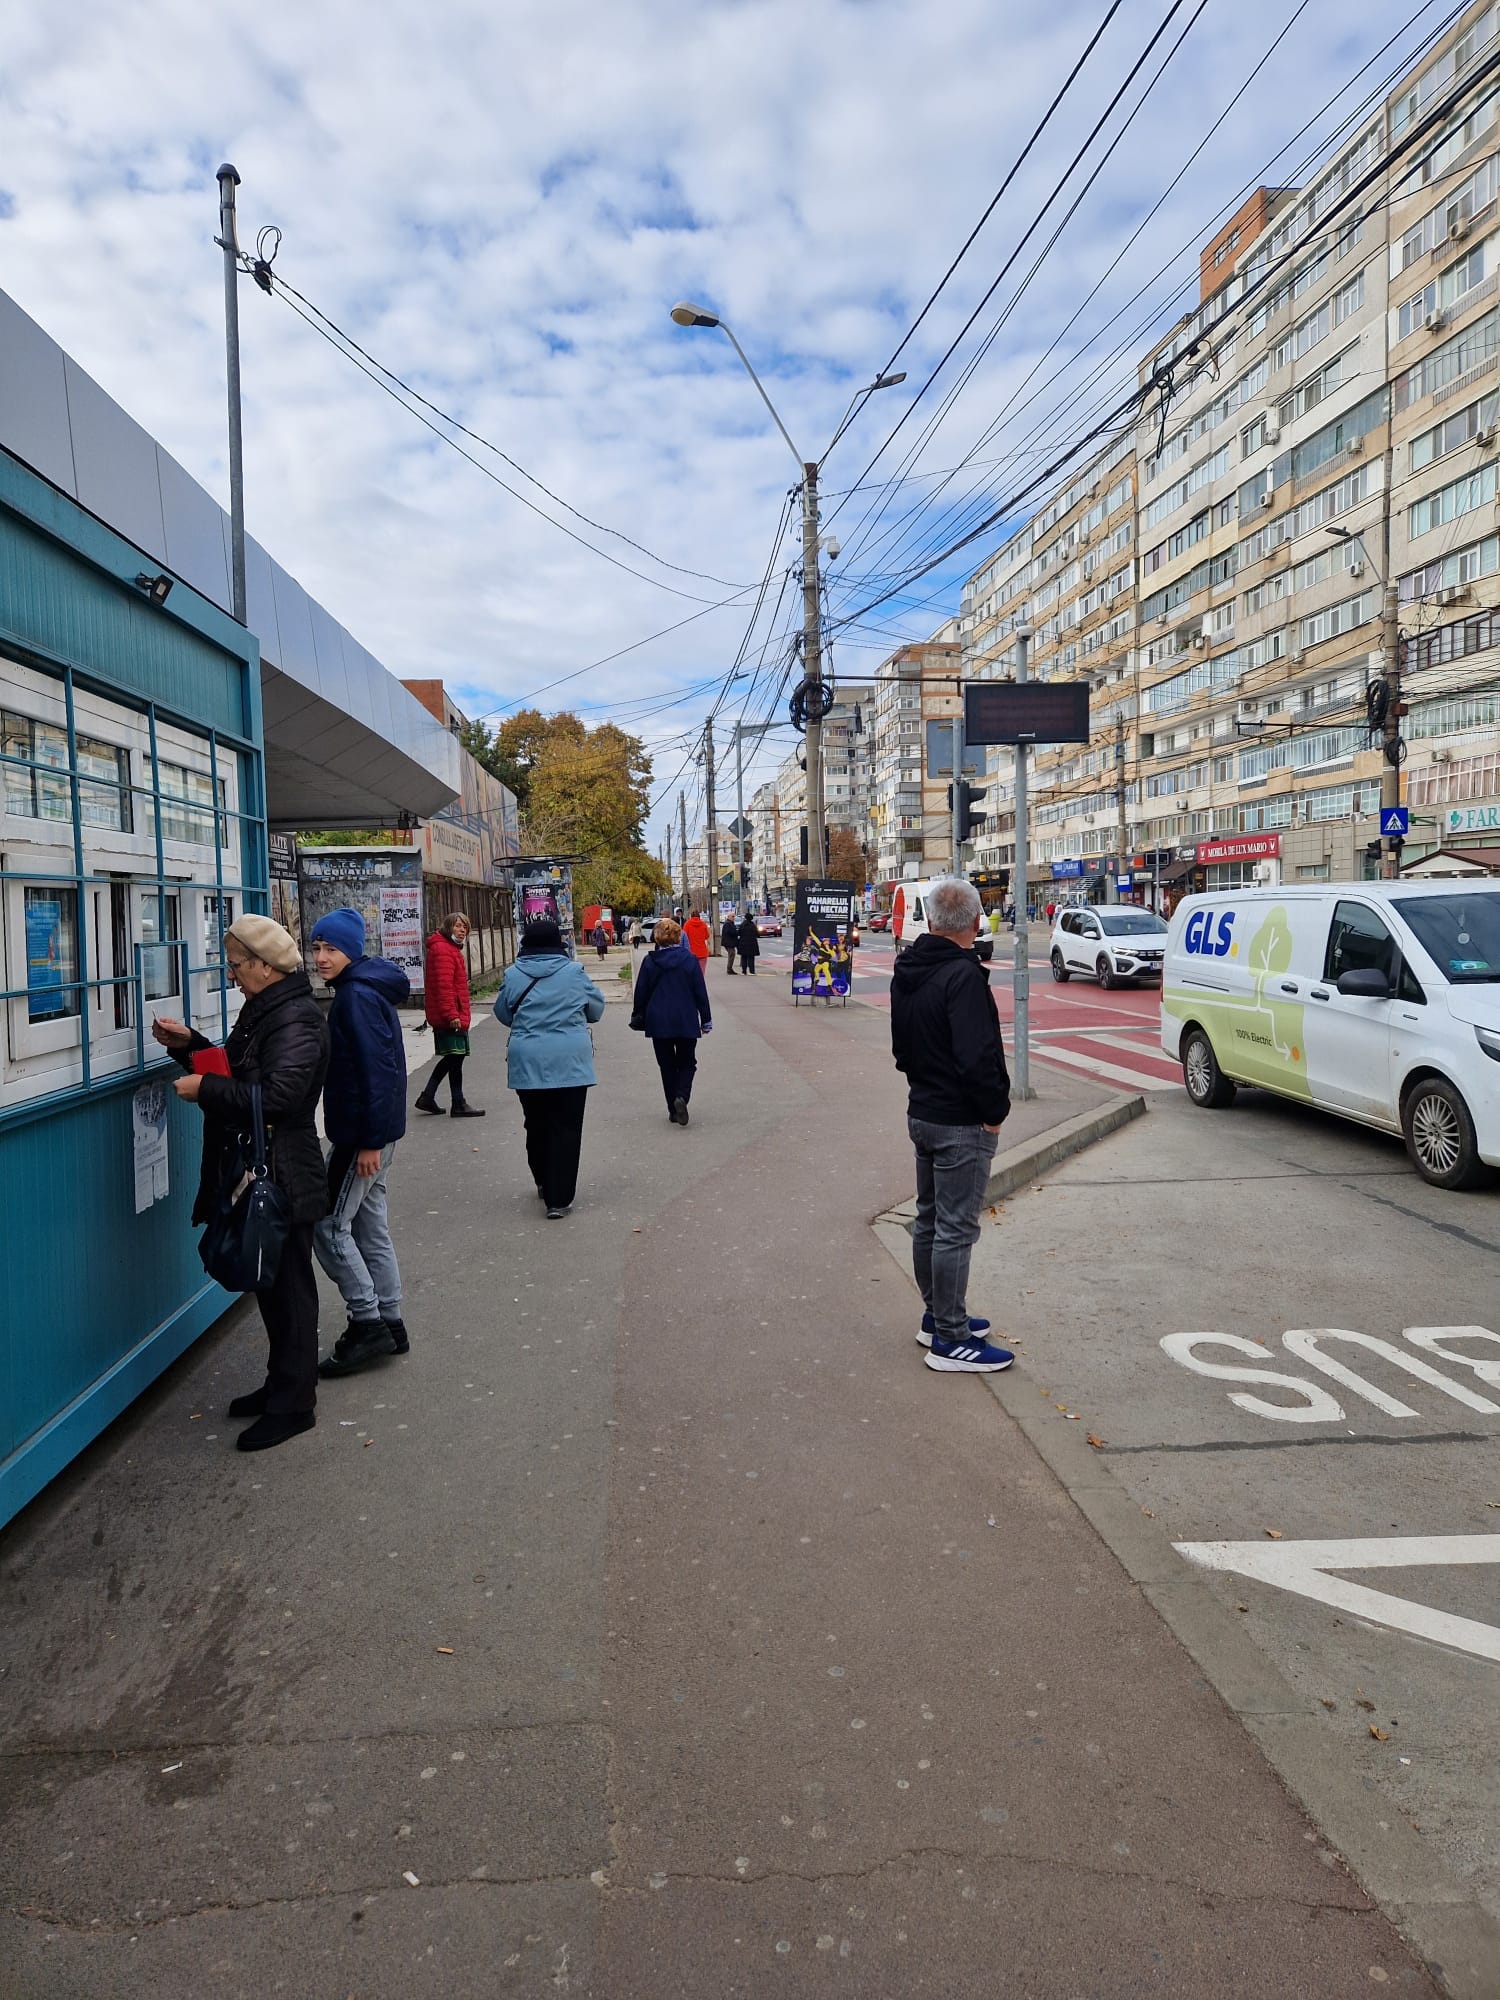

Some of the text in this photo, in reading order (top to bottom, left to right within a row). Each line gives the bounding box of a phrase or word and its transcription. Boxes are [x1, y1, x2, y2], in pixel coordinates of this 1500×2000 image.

[1228, 845, 1236, 856] DE
[1236, 844, 1247, 855] LUX
[1247, 842, 1267, 854] MARIO
[807, 896, 848, 905] PAHARELUL
[810, 905, 849, 914] CU NECTAR
[1235, 1029, 1273, 1047] 100% Electric
